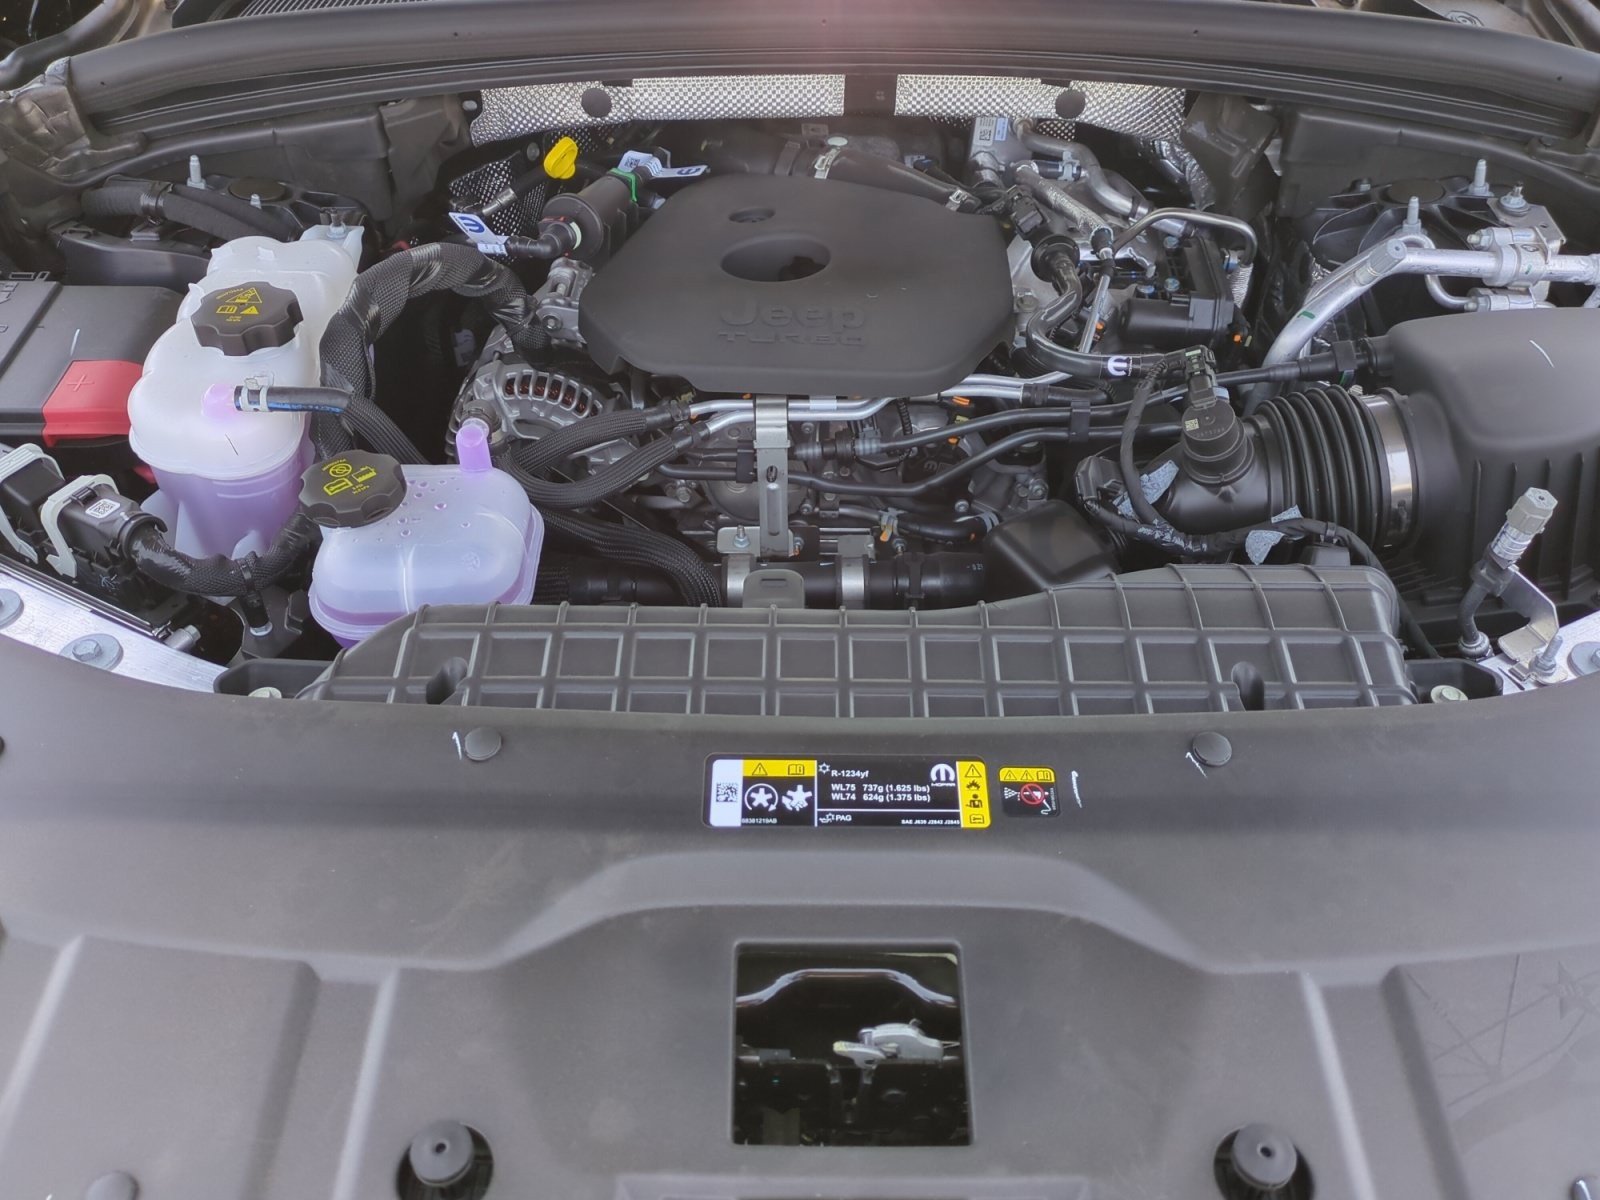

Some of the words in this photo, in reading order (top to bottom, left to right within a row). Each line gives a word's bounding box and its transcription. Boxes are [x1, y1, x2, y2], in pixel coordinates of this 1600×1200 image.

[720, 299, 866, 334] Jeep
[831, 770, 869, 778] R-1234yf
[831, 783, 856, 791] WL75
[862, 784, 884, 793] 737g
[885, 784, 912, 792] (1.625
[913, 784, 930, 793] lbs)
[831, 793, 856, 801] WL74
[862, 794, 884, 802] 624g
[886, 793, 912, 802] (1.375
[914, 794, 931, 802] lbs)
[835, 814, 852, 822] PAG
